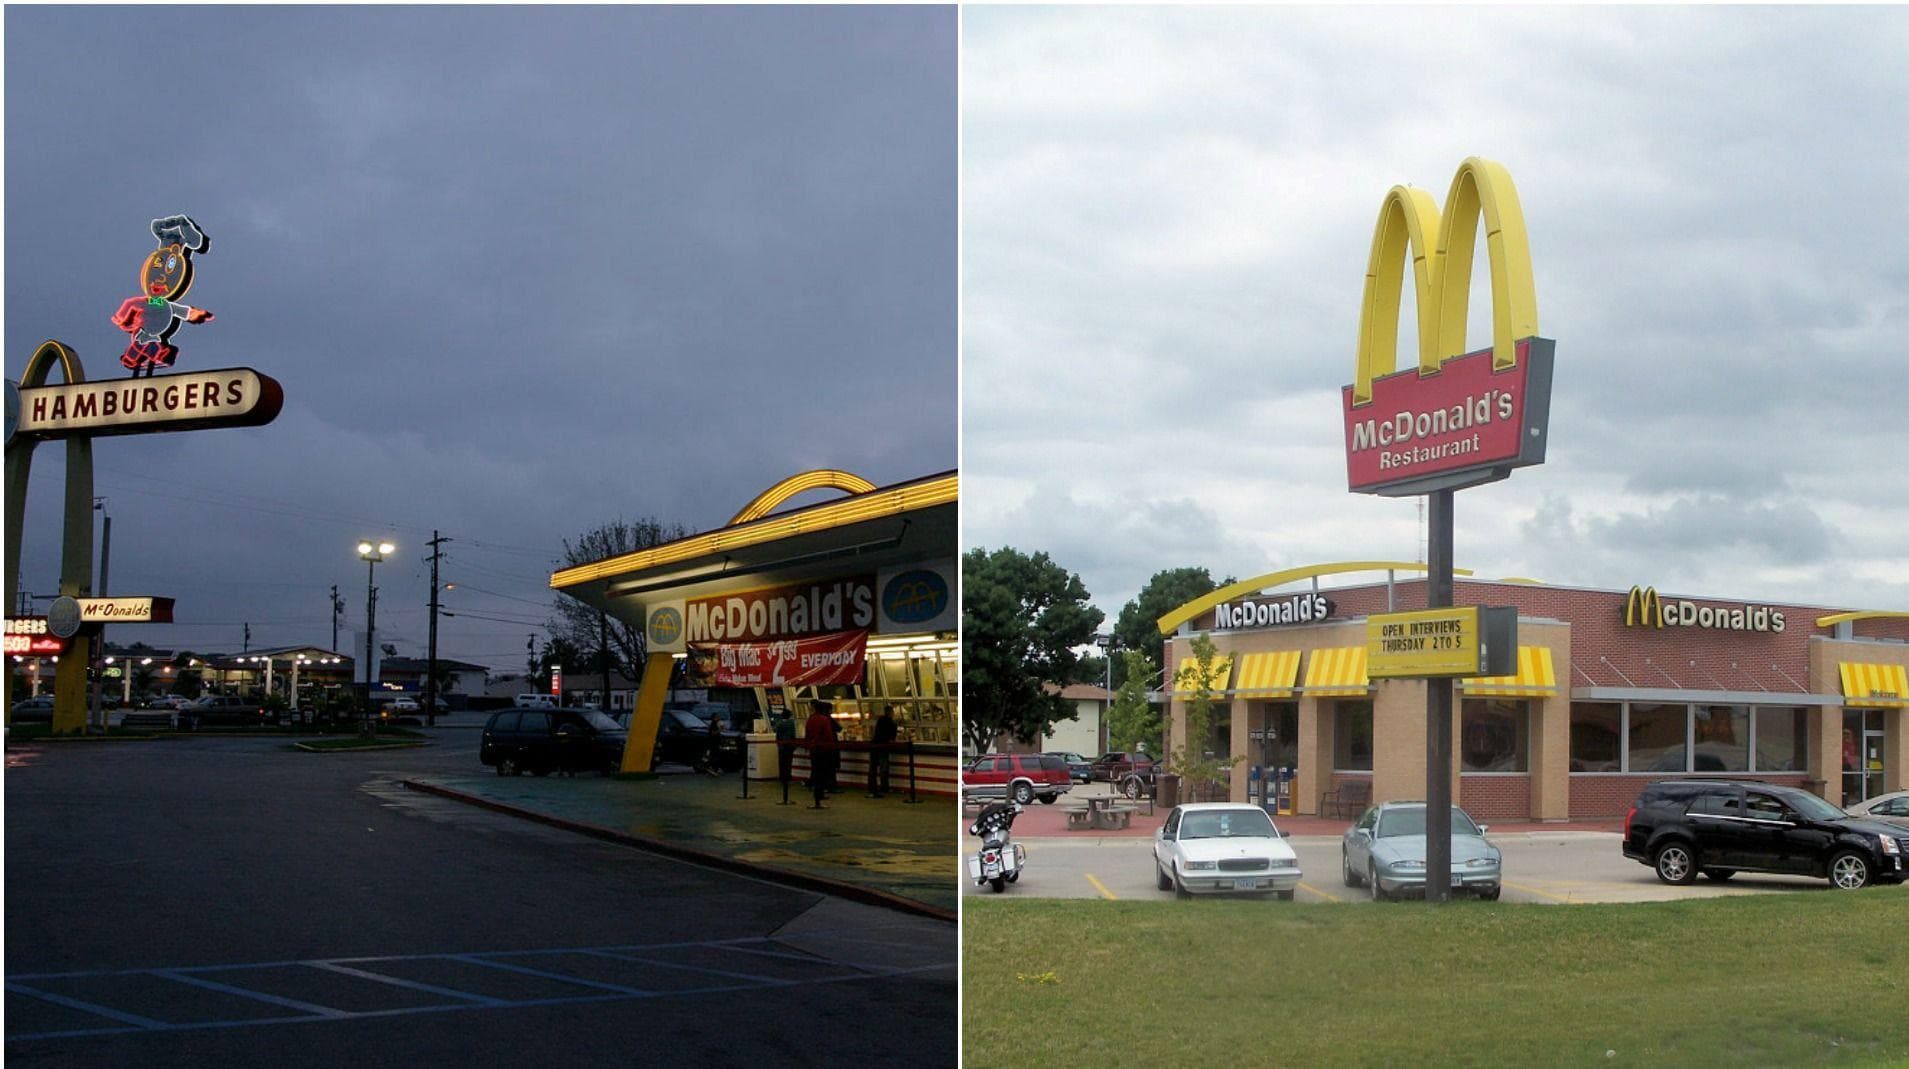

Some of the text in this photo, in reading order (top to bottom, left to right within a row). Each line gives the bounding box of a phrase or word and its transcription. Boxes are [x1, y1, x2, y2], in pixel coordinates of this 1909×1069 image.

[32, 380, 243, 422] HAMBURGERS
[1352, 389, 1514, 452] McDonald's
[1379, 433, 1480, 470] Restaurant
[4, 619, 47, 634] RGERS
[686, 582, 874, 642] McDonald's
[1215, 593, 1329, 629] McDonald's
[1382, 620, 1461, 637] OPEN INTERVIEWS
[720, 644, 737, 672] Big
[739, 644, 761, 667] Mac
[801, 648, 859, 668] EVERYDAY
[1381, 637, 1425, 652] THURSDAY
[1439, 636, 1452, 649] TO
[1456, 636, 1462, 648] 5
